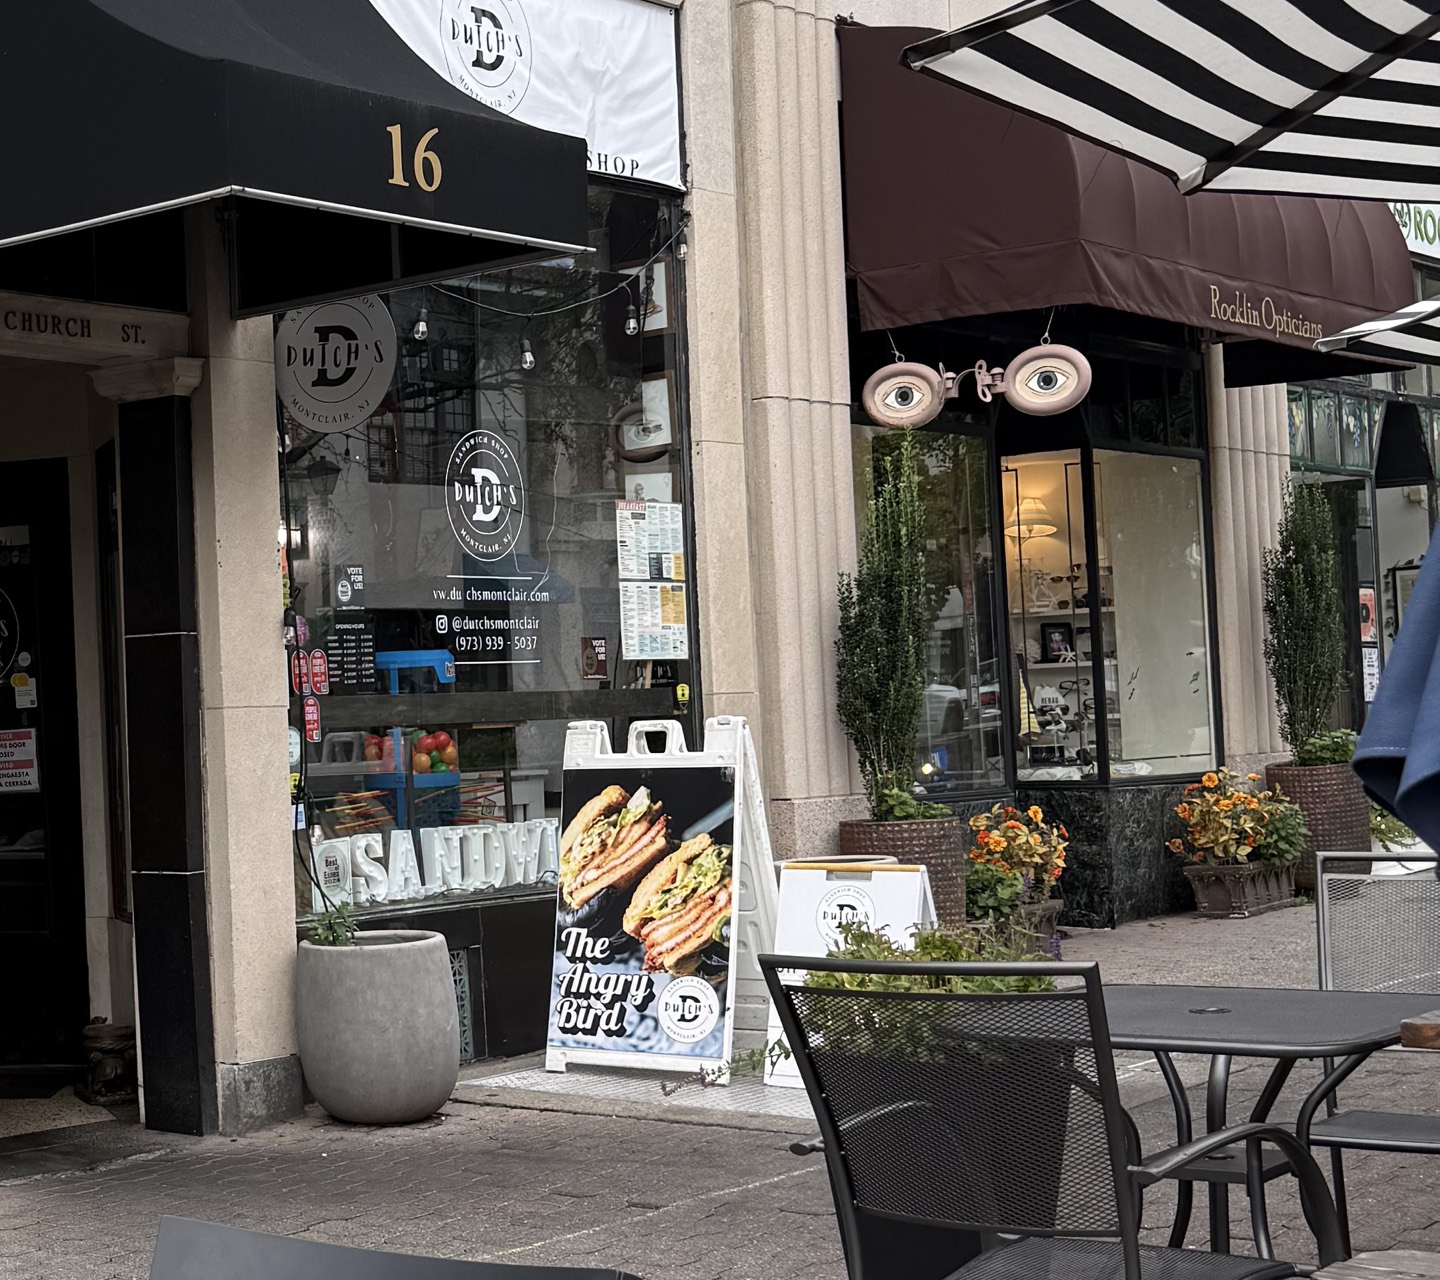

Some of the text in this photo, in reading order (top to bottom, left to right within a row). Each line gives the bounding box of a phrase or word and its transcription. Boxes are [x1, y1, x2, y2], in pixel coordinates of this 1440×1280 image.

[385, 123, 443, 192] 16
[1414, 204, 1440, 246] RO
[1209, 285, 1322, 338] Rocklin Opticians
[3, 311, 92, 338] CHURCH
[120, 323, 146, 345] ST.
[286, 339, 384, 367] DUTCH'S
[357, 399, 370, 412] NJ
[455, 435, 509, 464] SANDWICH SHOP
[454, 481, 517, 506] DUTCH'S
[503, 533, 511, 545] NJ
[452, 616, 540, 632] @dutchsmontclair
[455, 635, 483, 651] (973)
[485, 636, 504, 650] 939
[514, 636, 537, 650] 5037
[560, 927, 611, 959] The
[558, 961, 651, 1006] Angry
[555, 998, 622, 1031] Bird
